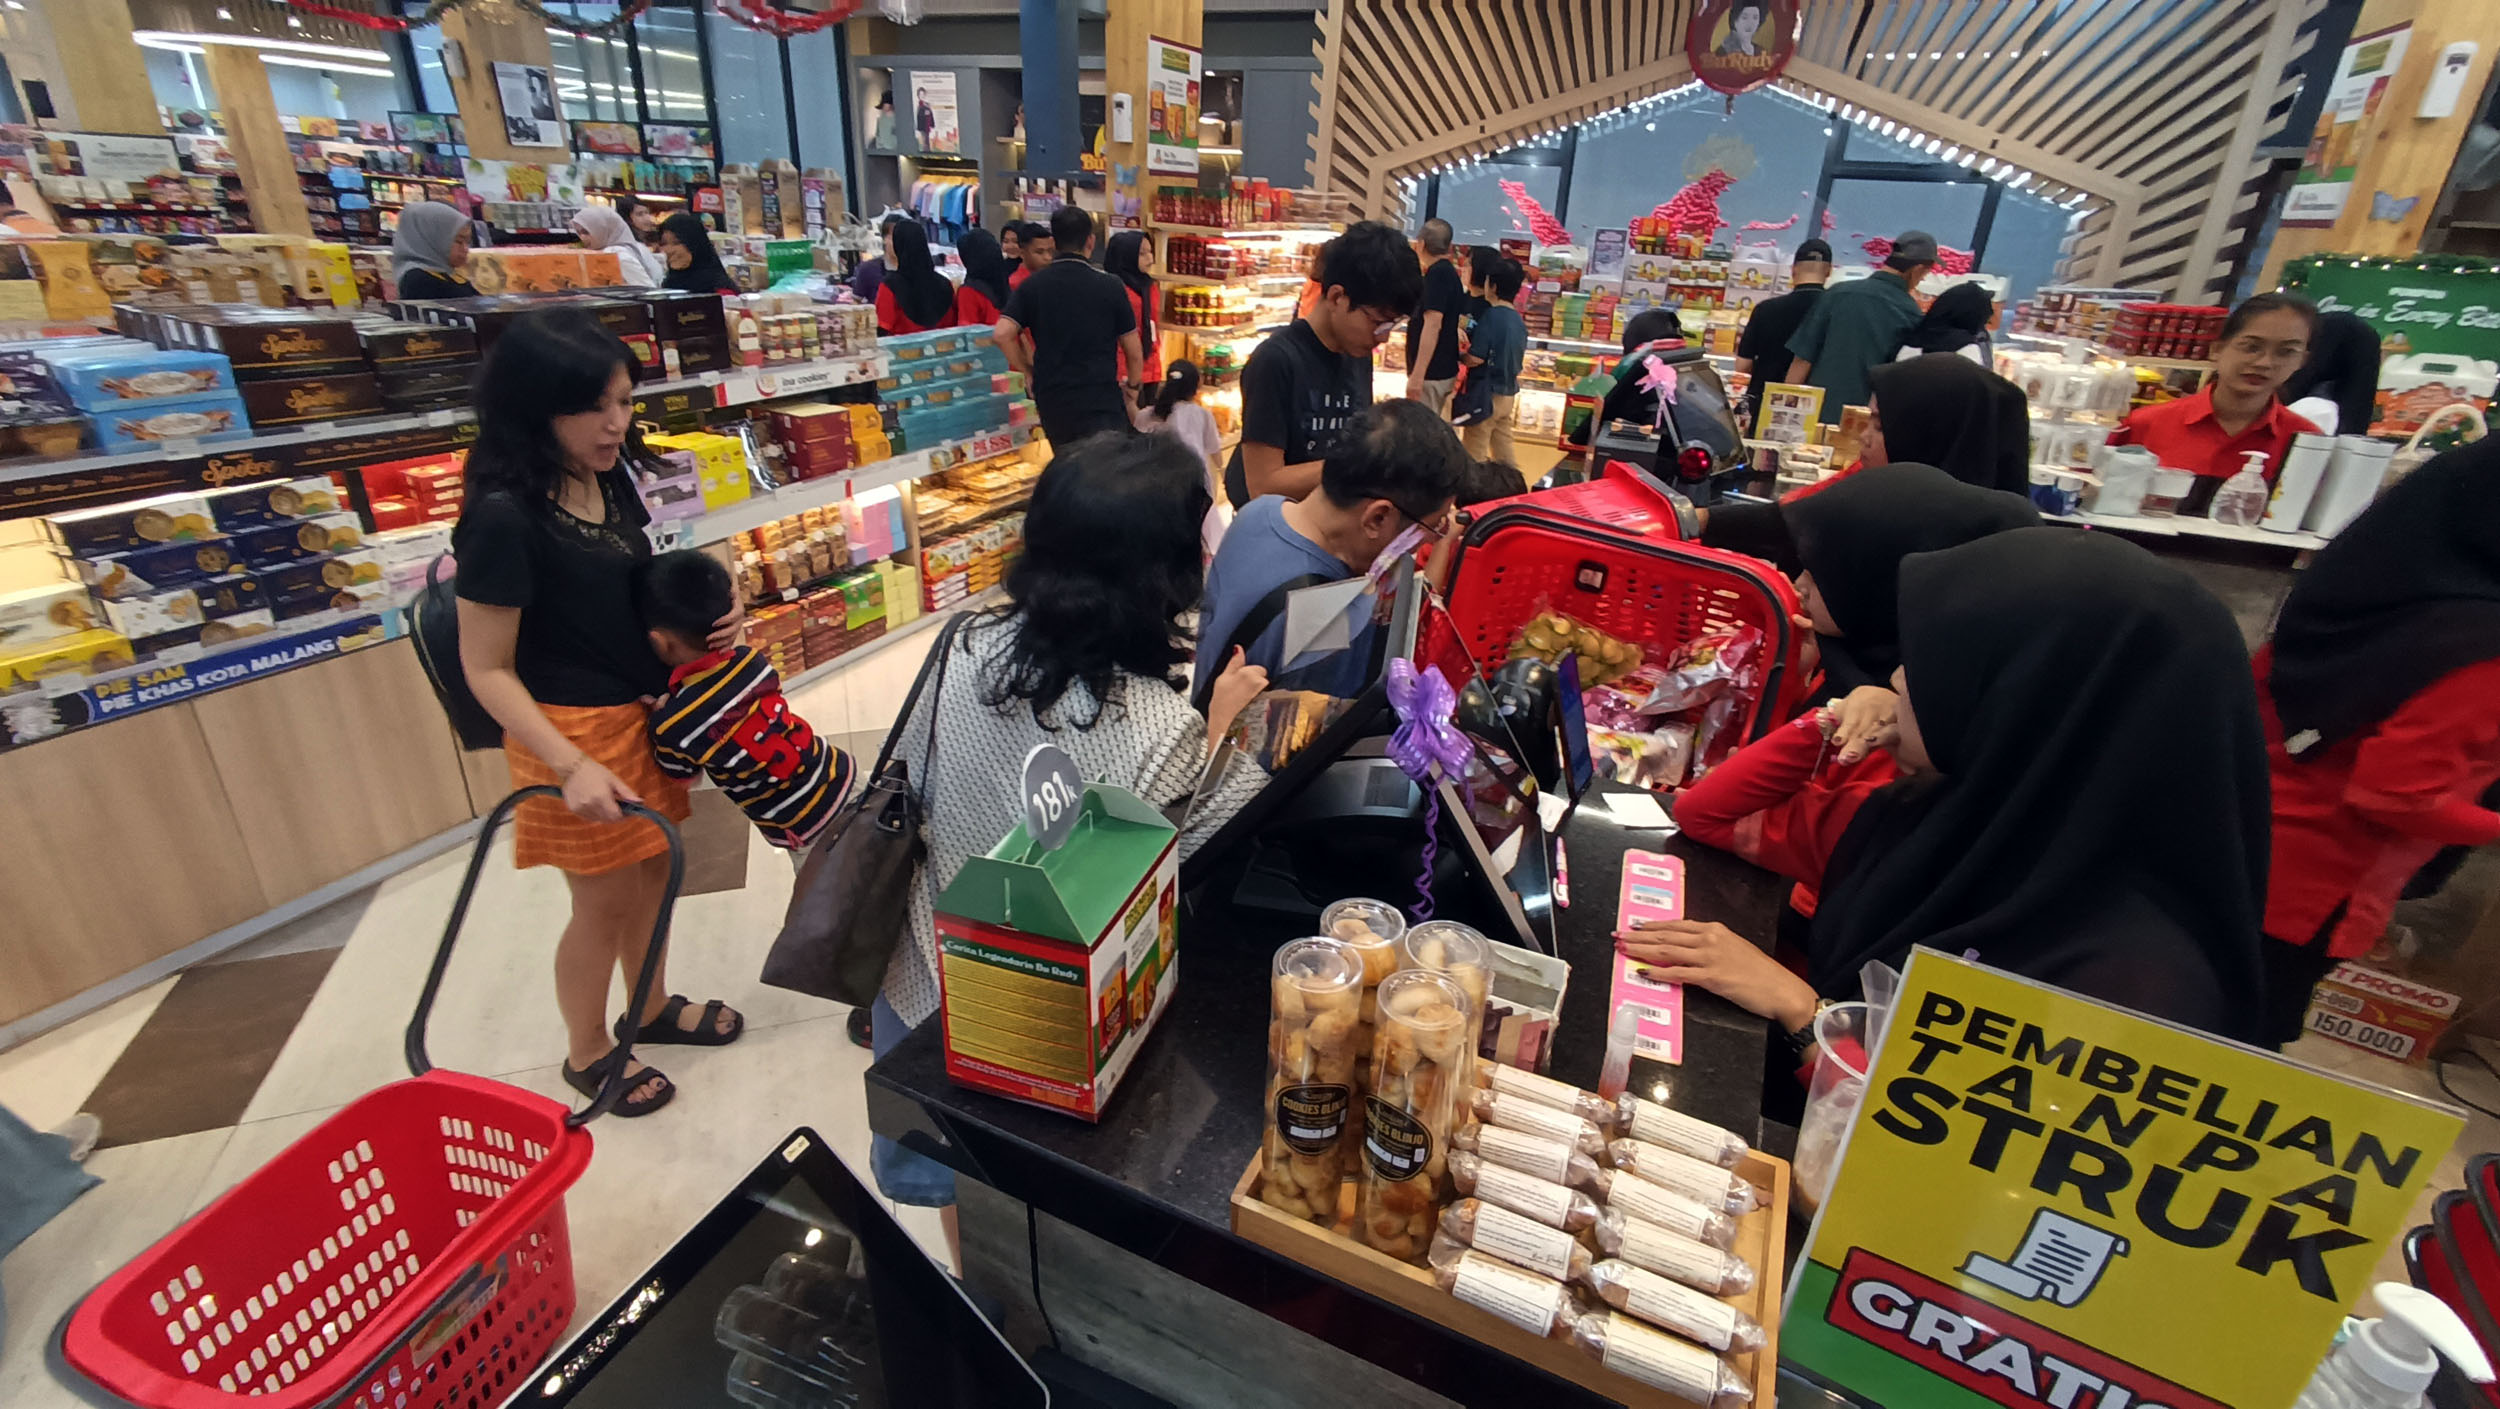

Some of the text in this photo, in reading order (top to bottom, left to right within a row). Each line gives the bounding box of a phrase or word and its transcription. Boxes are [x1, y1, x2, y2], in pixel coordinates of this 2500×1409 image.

[95, 665, 187, 698] PIE SAM
[100, 639, 335, 713] PIE KHAS KOTA MALANG
[1051, 967, 1079, 981] Rudy
[2351, 973, 2450, 1009] PROMO
[2313, 1011, 2406, 1054] 150.000
[1282, 1096, 1319, 1116] COOKIES
[1915, 991, 2423, 1189] PEMBELIAN
[1906, 1031, 2358, 1226] TANPA
[1872, 1076, 2373, 1303] STRUK
[1850, 1280, 2174, 1409] GRATI
